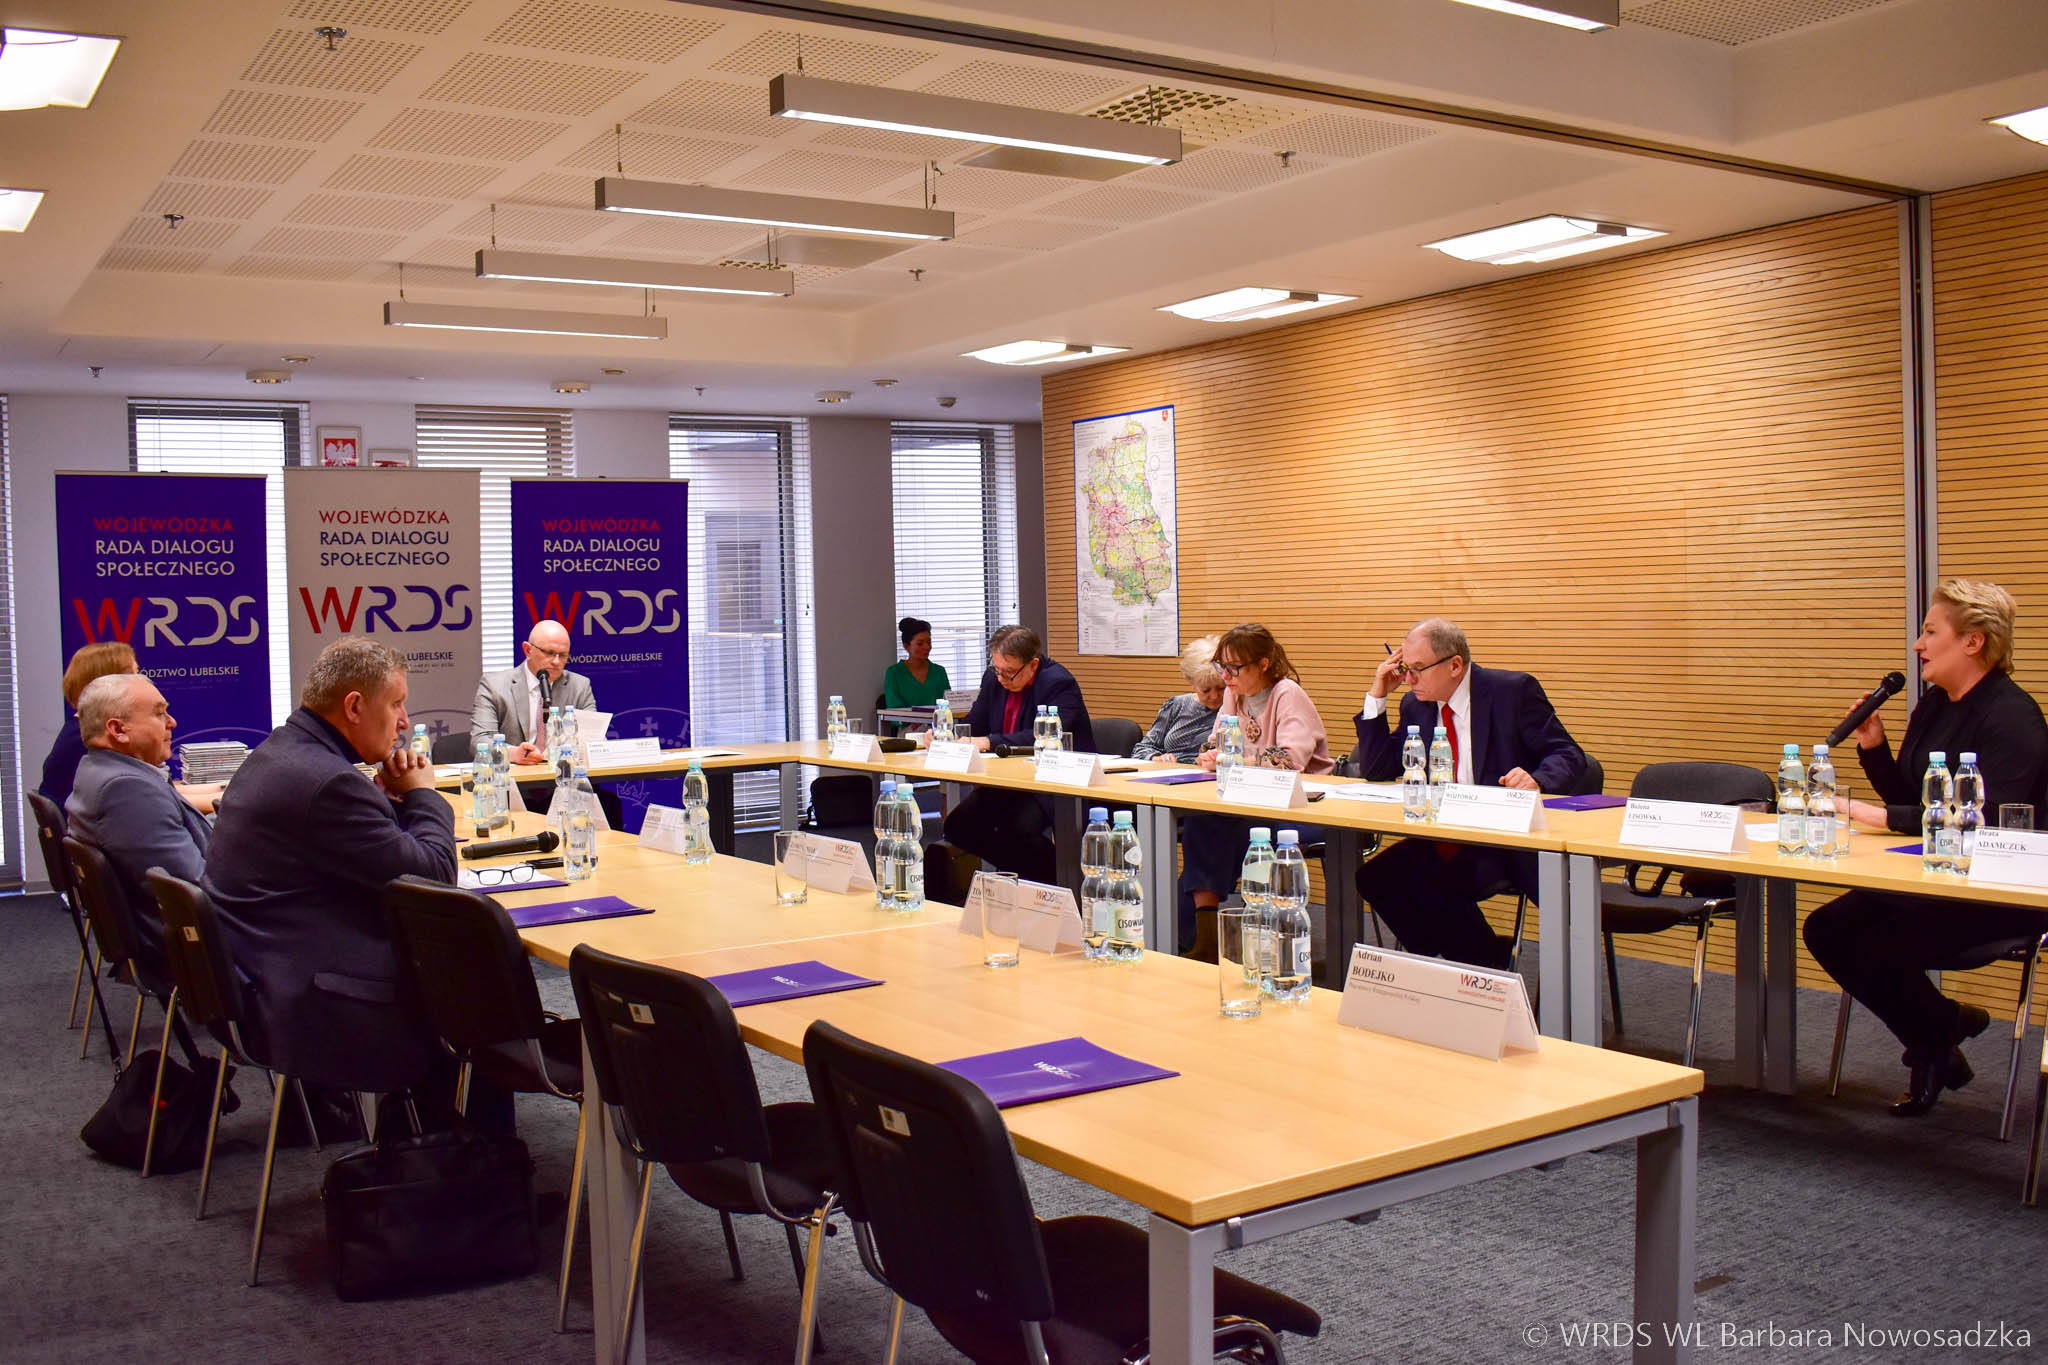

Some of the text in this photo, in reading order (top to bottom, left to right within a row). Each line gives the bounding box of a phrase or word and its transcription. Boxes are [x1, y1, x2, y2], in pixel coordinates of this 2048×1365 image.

[319, 507, 450, 524] WOJEWÓDZKA
[320, 530, 449, 546] RADA DIALOGU
[543, 537, 660, 553] RADA DIALOGU
[96, 539, 234, 555] RADA DIALOGU
[320, 551, 450, 567] SPOŁECZNEGO
[543, 557, 661, 573] SPOŁECZNEGO
[96, 560, 235, 577] SPOŁECZNEGO
[298, 584, 473, 634] WRDS
[522, 588, 681, 636] WRDS
[72, 595, 260, 648] WRDS
[407, 651, 454, 661] LUBELSKIE
[569, 652, 663, 663] WÓDZTWO LUBELSKIE
[189, 666, 240, 676] LUBELSKIE
[1977, 841, 2027, 852] ADAMCZUK
[1357, 950, 1382, 963] Adrian
[1352, 965, 1395, 983] BODEJKO
[1460, 973, 1493, 991] WRDS
